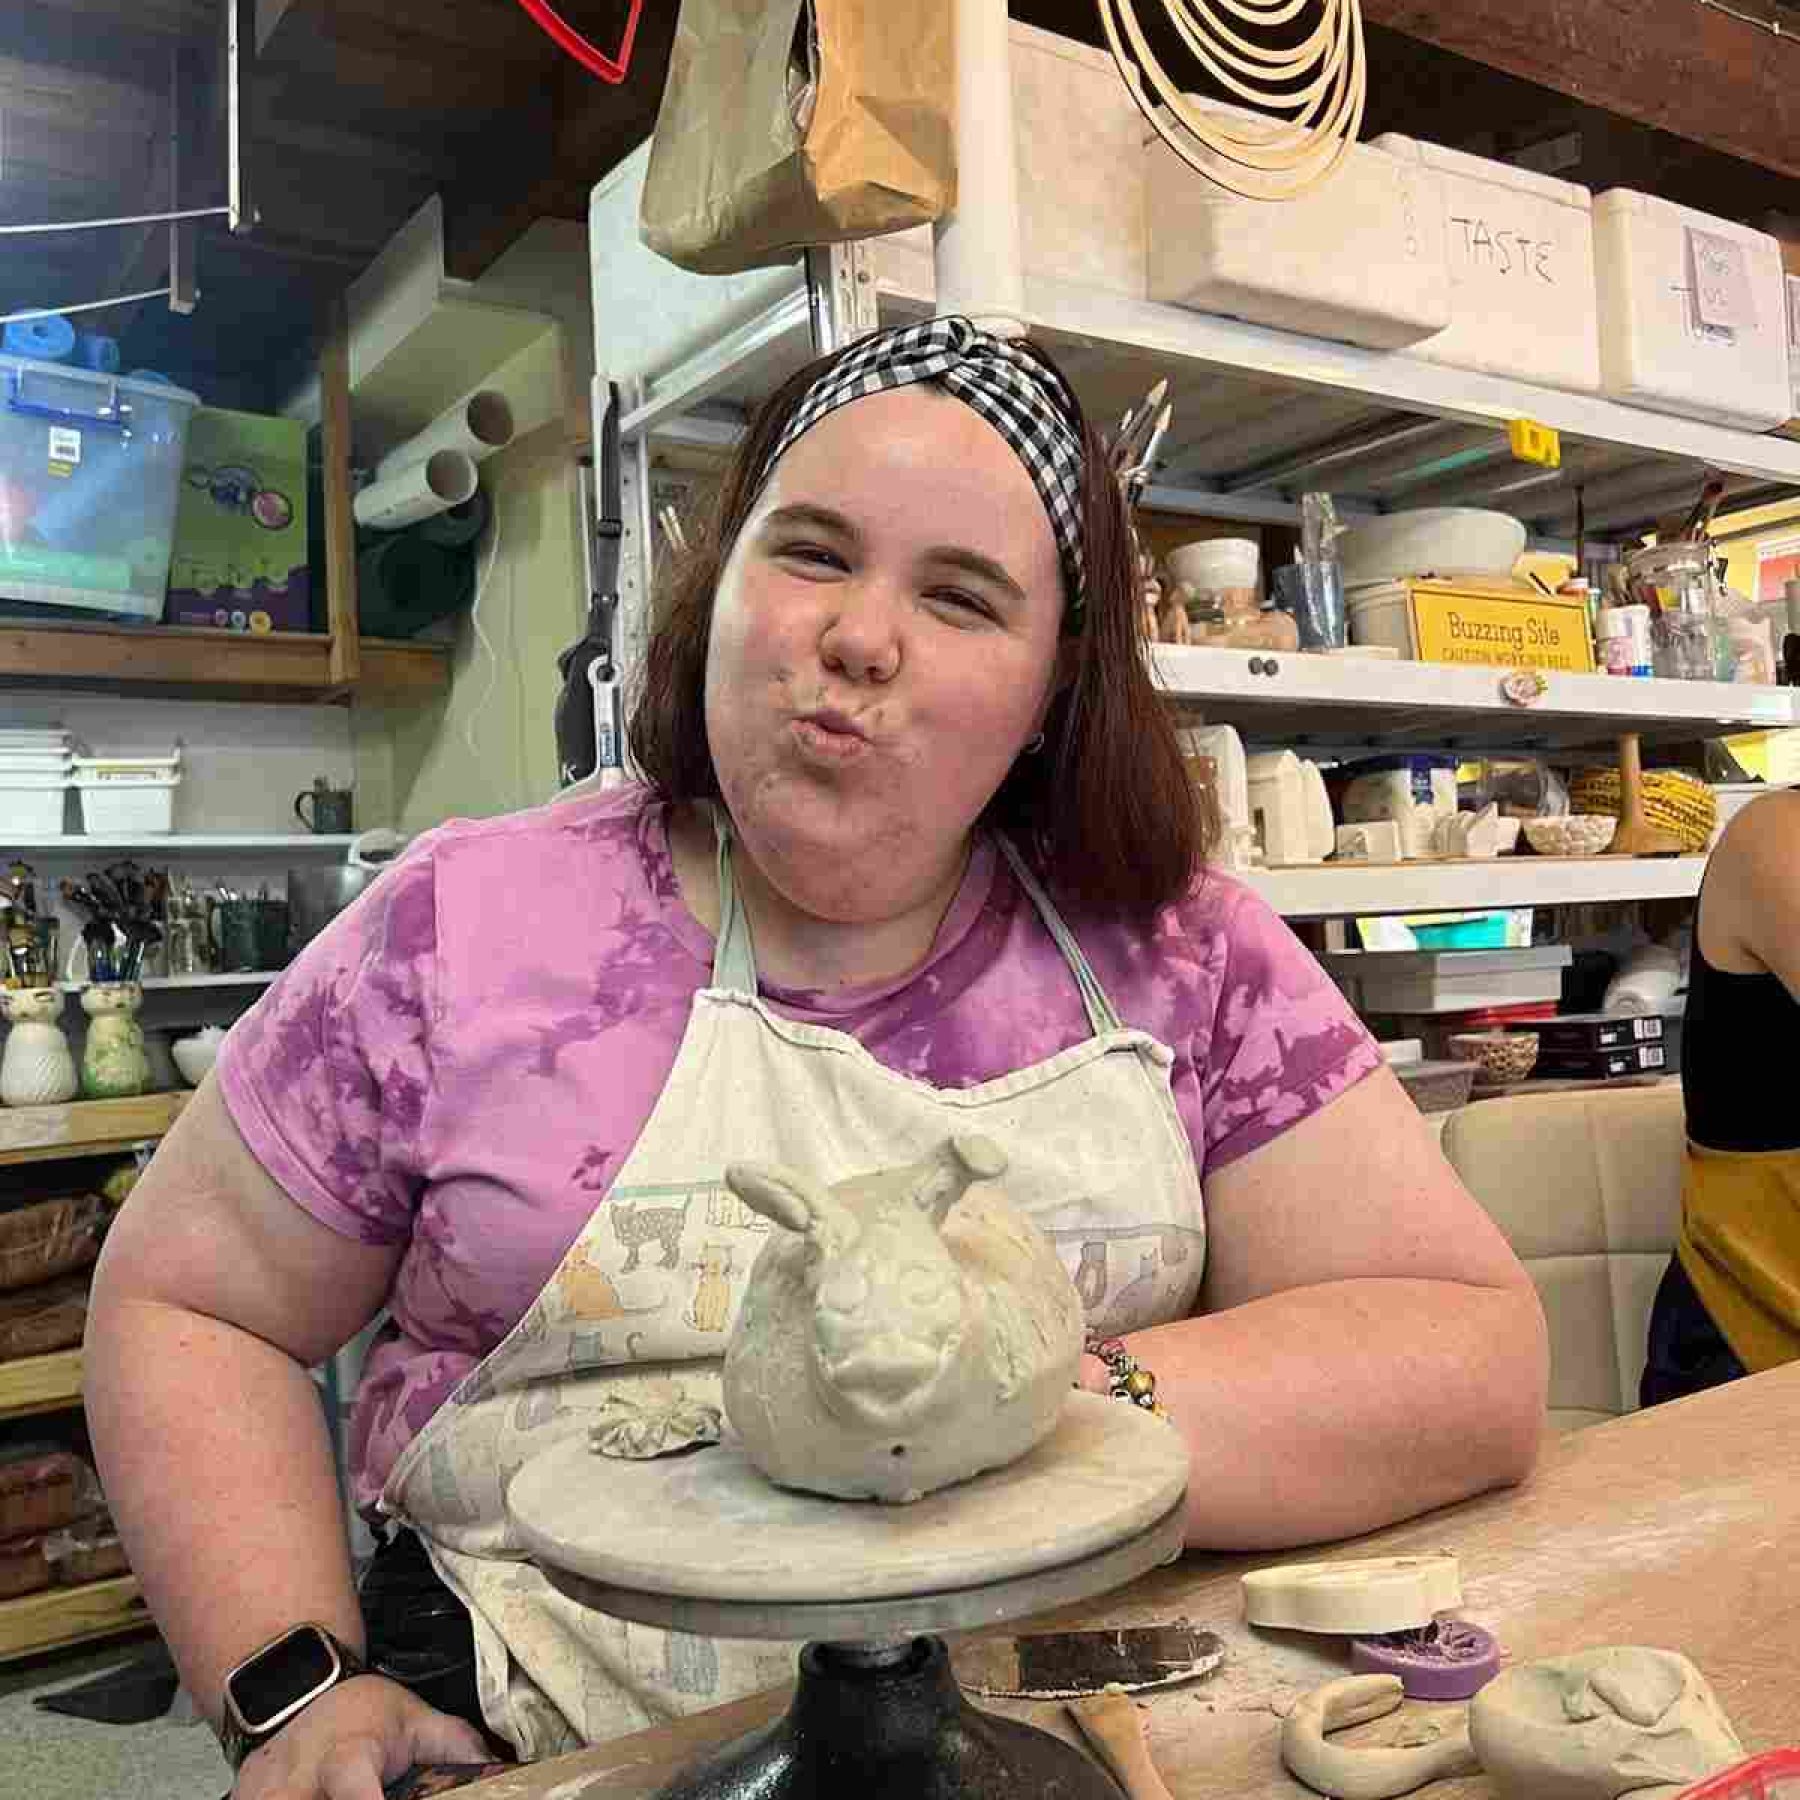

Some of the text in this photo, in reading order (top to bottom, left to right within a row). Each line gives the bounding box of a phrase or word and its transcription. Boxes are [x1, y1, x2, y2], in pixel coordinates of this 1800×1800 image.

[1451, 216, 1555, 284] TASTE
[1446, 611, 1561, 650] Buzzing Site
